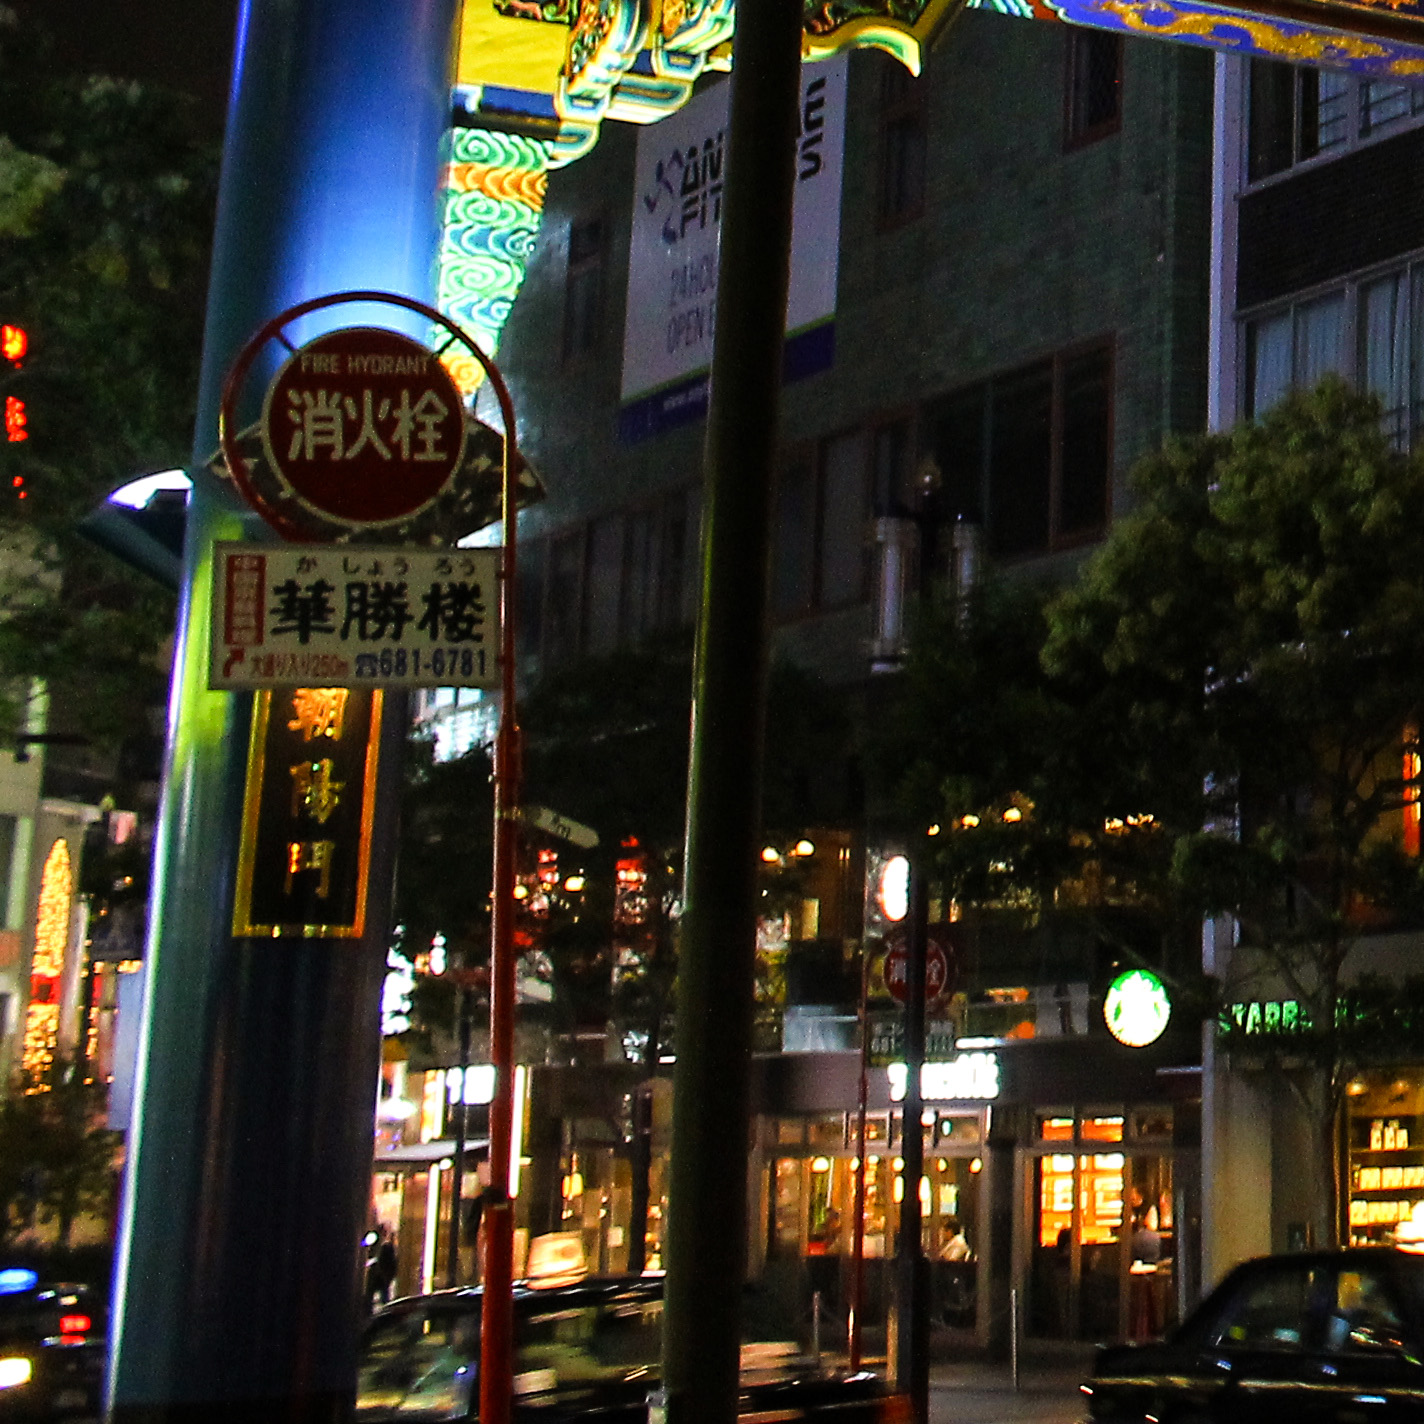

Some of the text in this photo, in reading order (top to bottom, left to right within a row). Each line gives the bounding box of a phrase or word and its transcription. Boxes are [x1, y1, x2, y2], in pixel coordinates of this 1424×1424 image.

[301, 352, 429, 375] FIRE HYDRANT
[287, 388, 450, 462] 消火栓
[269, 578, 486, 645] 華勝楼
[380, 647, 486, 678] 681-6781
